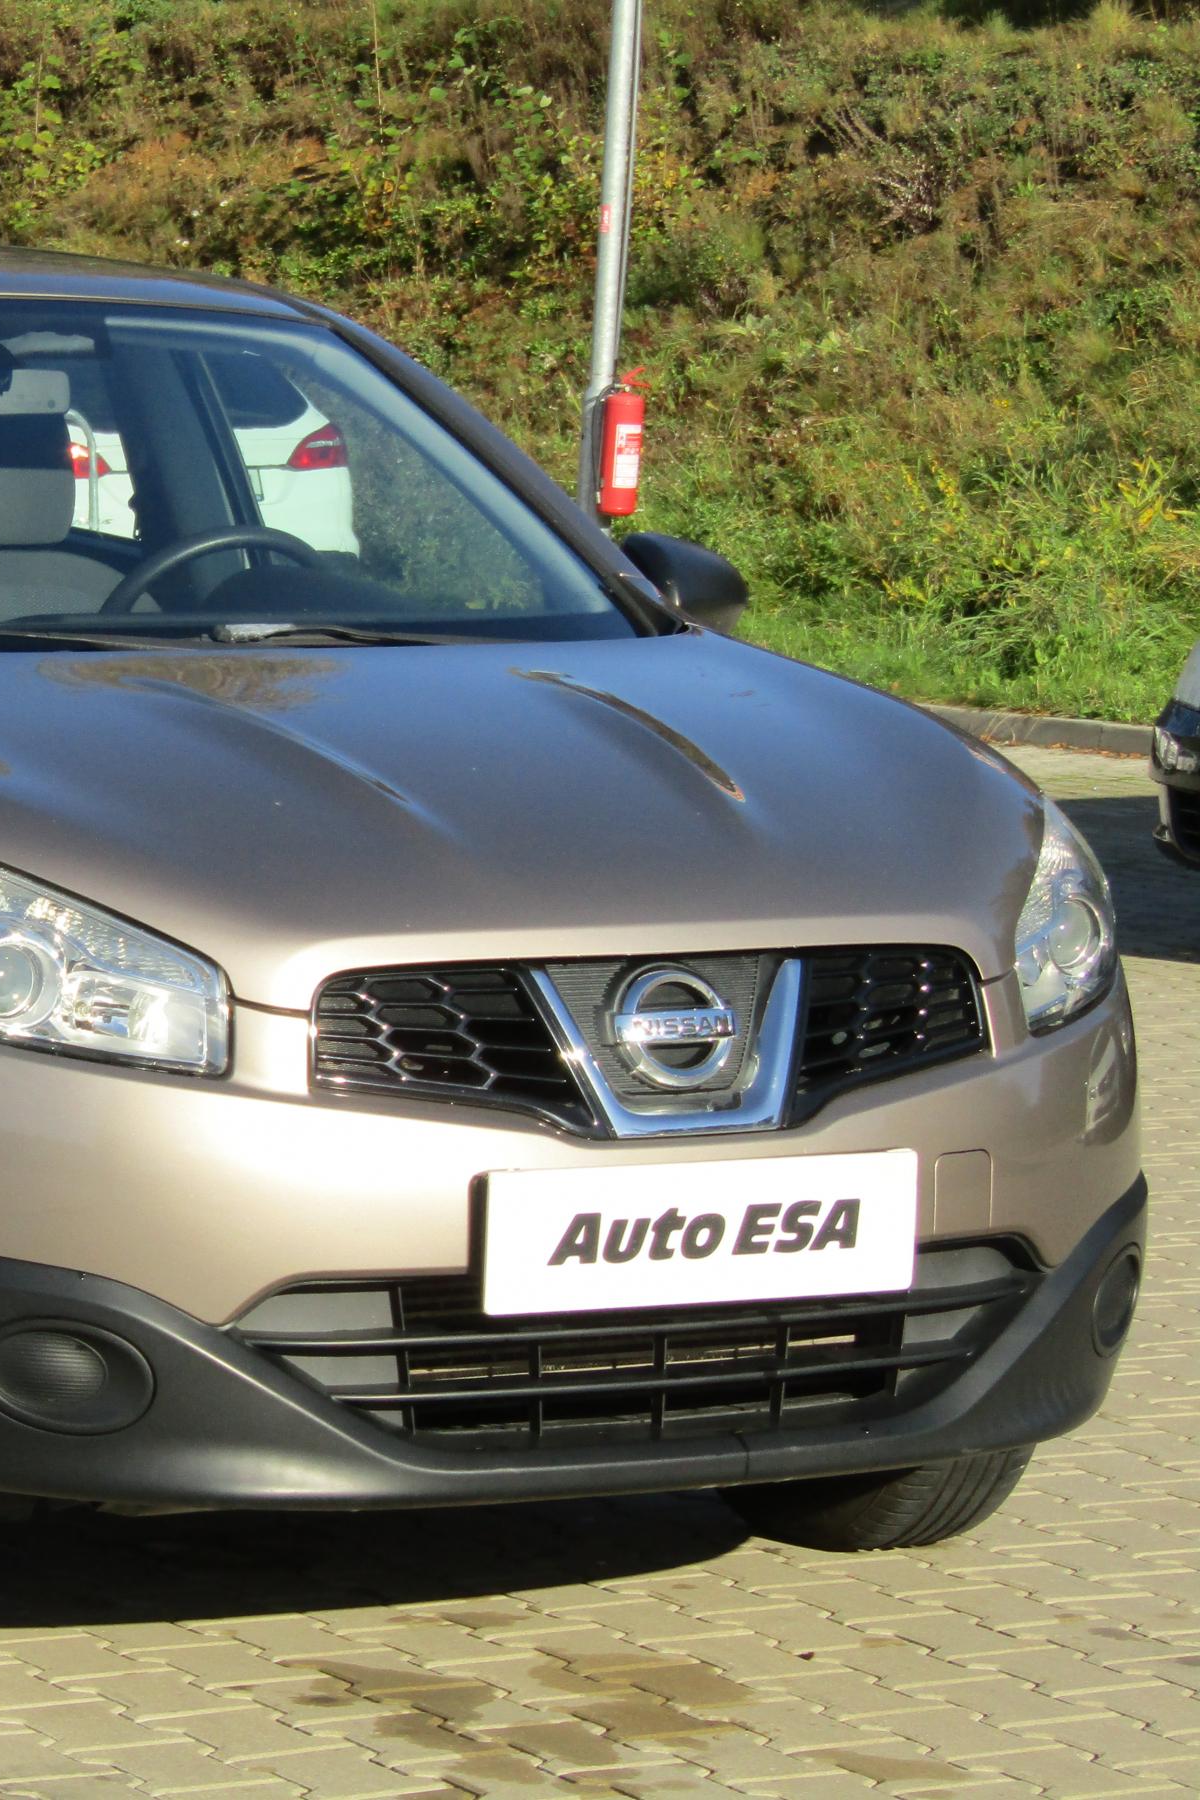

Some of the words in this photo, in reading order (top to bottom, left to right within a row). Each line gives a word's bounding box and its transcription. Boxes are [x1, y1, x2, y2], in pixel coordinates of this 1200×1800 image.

[632, 1014, 731, 1037] NISSAN
[547, 1207, 726, 1266] Auto
[732, 1198, 861, 1256] ESA
